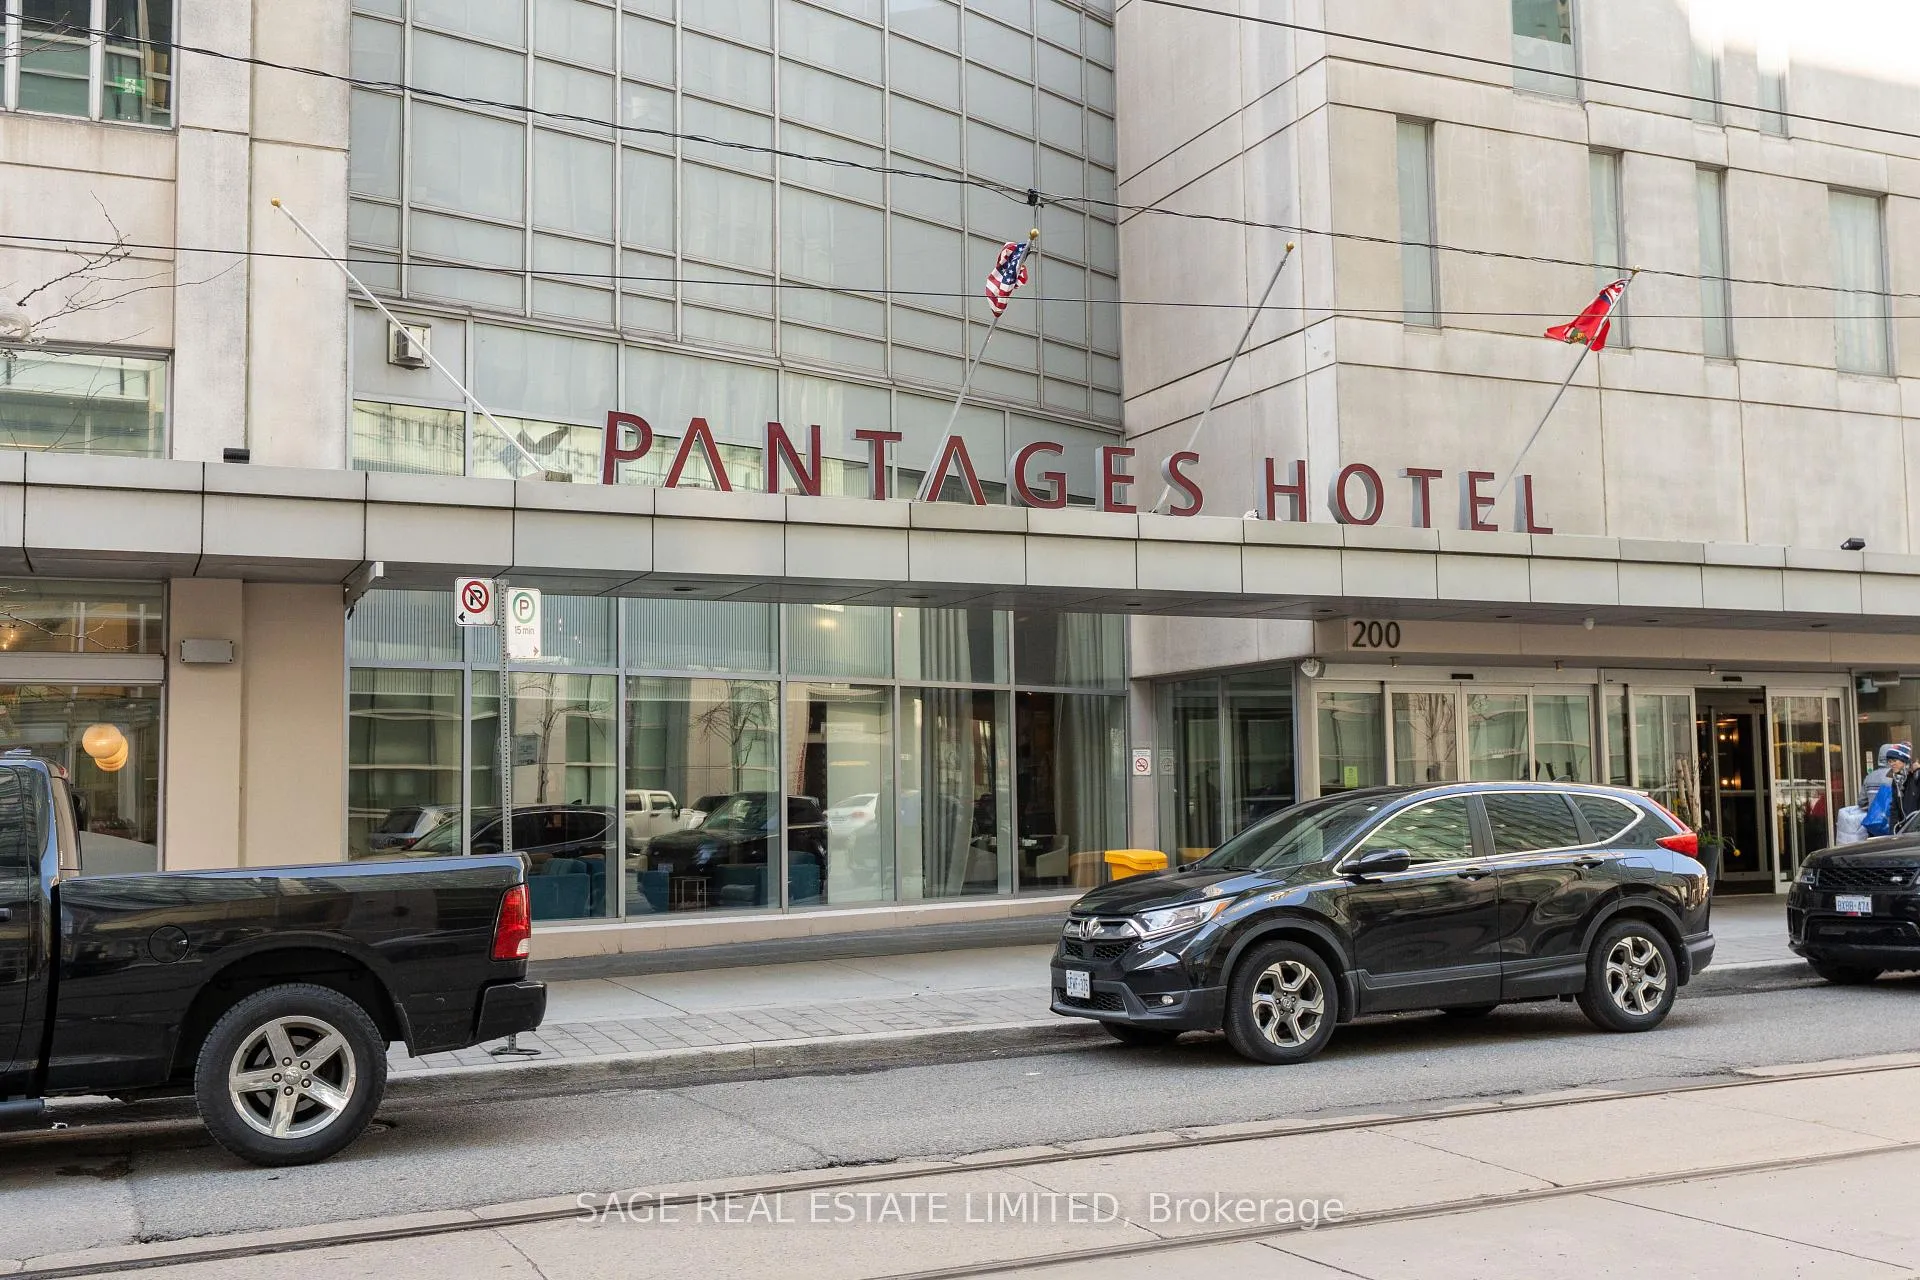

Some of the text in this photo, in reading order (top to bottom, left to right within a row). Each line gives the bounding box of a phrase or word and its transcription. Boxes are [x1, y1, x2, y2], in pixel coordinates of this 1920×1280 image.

[602, 410, 1554, 534] PANTAGES HOTEL
[519, 599, 529, 616] P
[522, 626, 535, 635] min
[1352, 621, 1400, 648] 200
